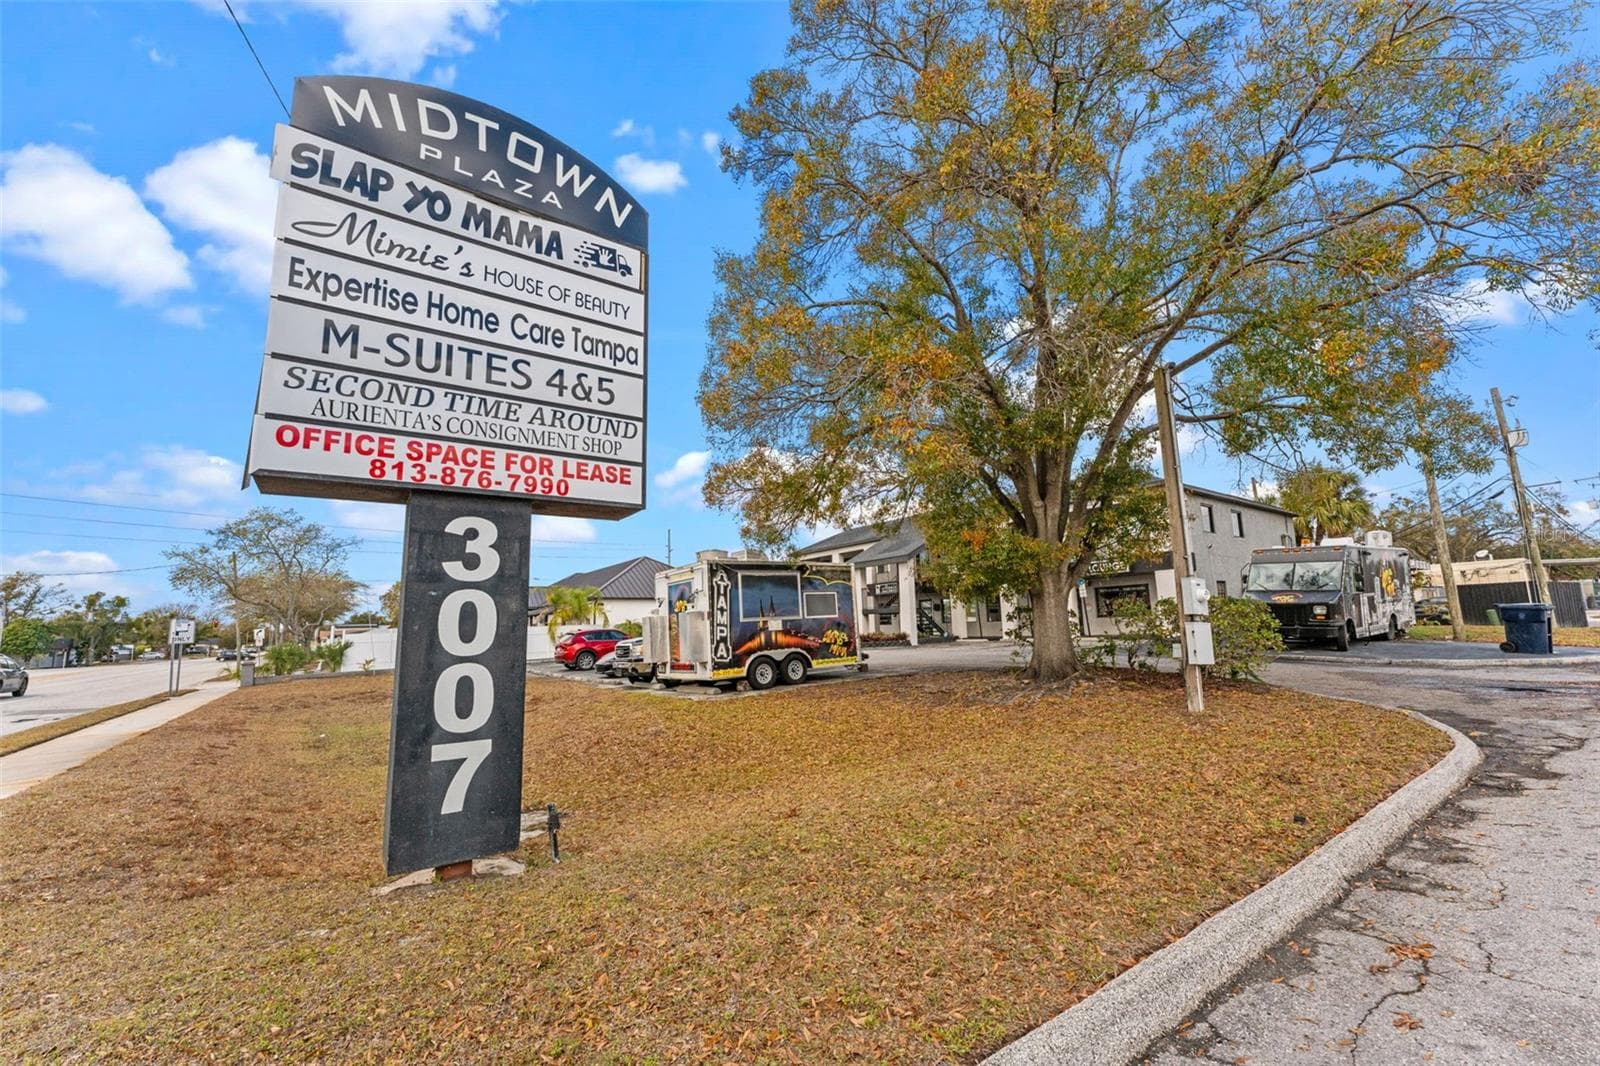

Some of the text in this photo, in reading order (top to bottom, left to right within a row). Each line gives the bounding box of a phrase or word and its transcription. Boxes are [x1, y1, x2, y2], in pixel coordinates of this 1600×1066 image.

[323, 85, 633, 228] MIDTOWN
[419, 143, 563, 209] PLAZA
[291, 142, 564, 260] SLAP YO MAMA
[291, 212, 630, 320] Mimie's HOUSE OF BEAUTY
[288, 256, 638, 367] Expertise Home Care Tampa
[283, 366, 638, 440] SECOND TIME AROUND
[321, 318, 616, 406] M-SUITES 4&5
[275, 424, 632, 485] OFFICE SPACE FOR LEASE
[311, 397, 622, 456] AURIENTA'S CONSIGNMENT SHOP
[369, 459, 570, 497] 813-876-7990
[430, 516, 500, 815] 3007
